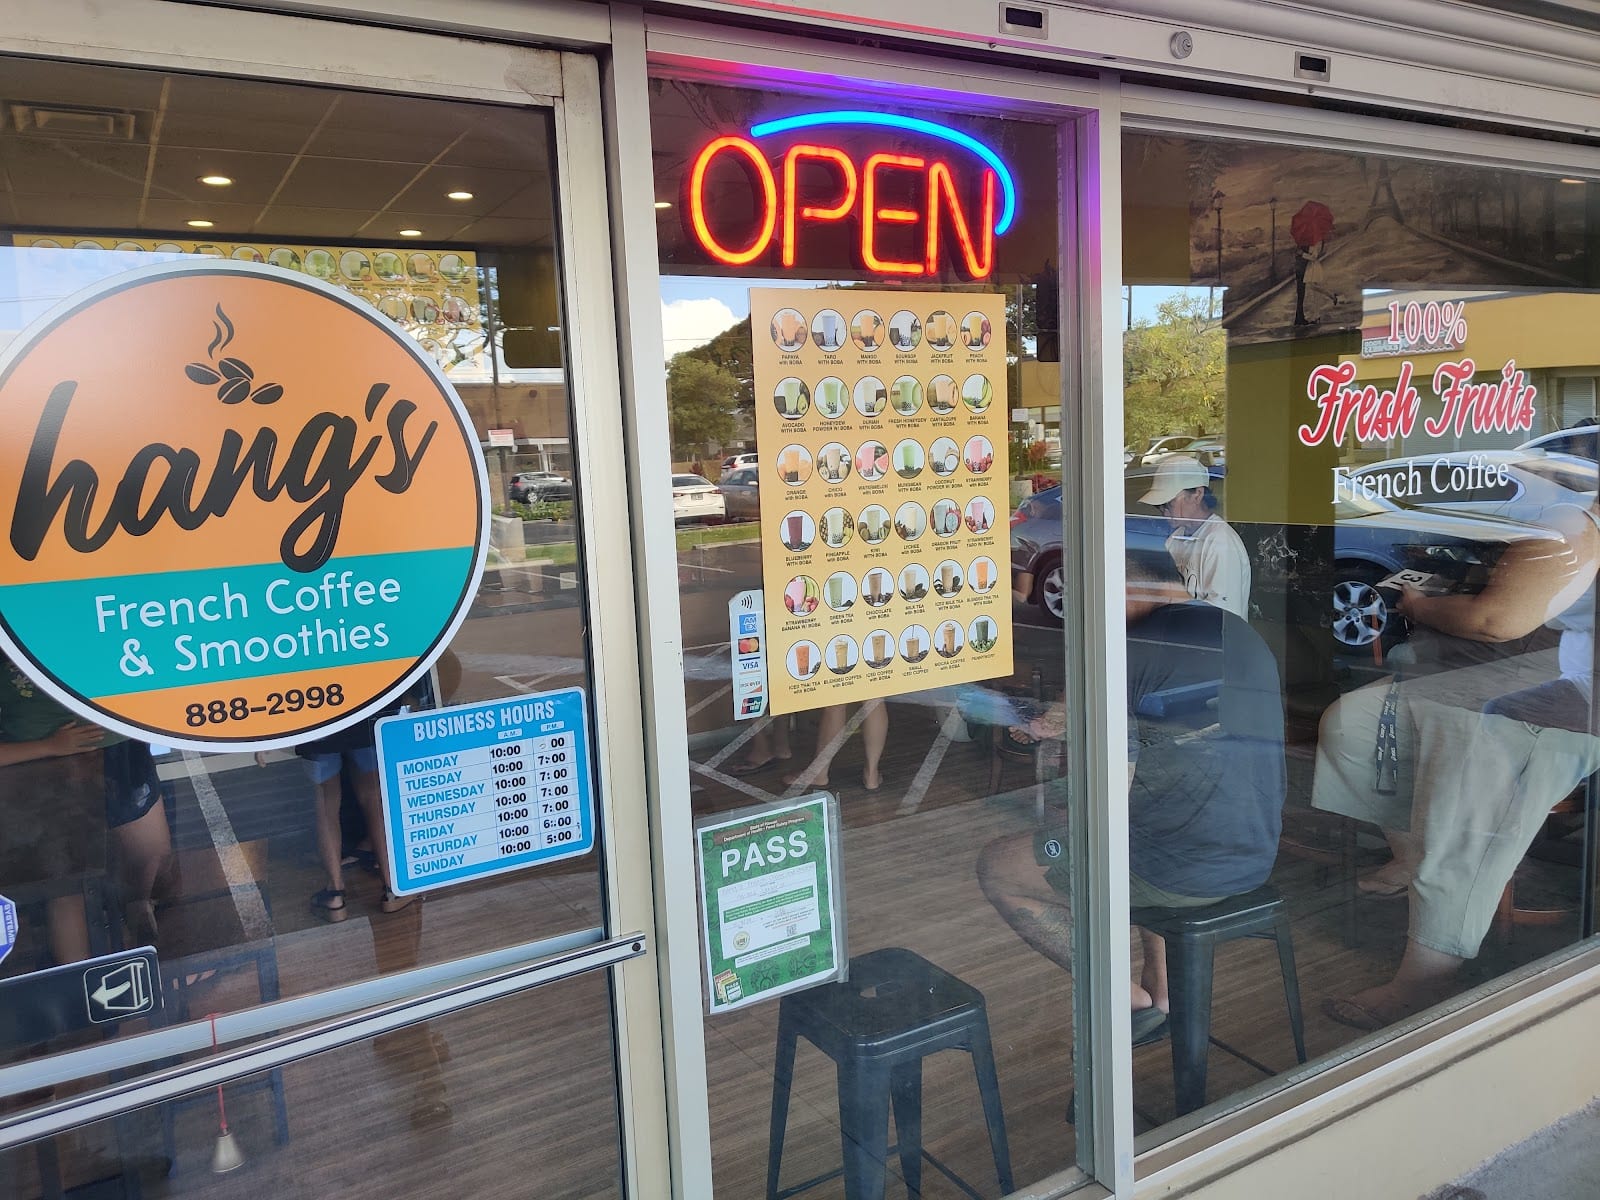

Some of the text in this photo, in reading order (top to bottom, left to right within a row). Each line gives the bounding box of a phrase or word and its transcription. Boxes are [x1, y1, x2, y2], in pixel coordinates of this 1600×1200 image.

[690, 134, 996, 280] OPEN
[1387, 300, 1468, 345] 100%
[1298, 358, 1537, 448] Fresh Fruits
[10, 380, 438, 574] hang's
[1330, 453, 1509, 504] French Coffee
[95, 570, 401, 633] French Coffee
[118, 618, 389, 678] & Smoothies
[742, 661, 759, 670] VISA
[185, 682, 345, 727] 888-2998
[413, 700, 555, 742] BUSINESS HOURS
[403, 754, 459, 776] MONDAY
[489, 744, 521, 759] 10:00
[405, 752, 566, 792] TUESDAY 10:00 7:00
[407, 768, 568, 809] WEDNESDAY 10:00 7:00
[409, 784, 569, 826] THURSDAY 10:00 7:00
[410, 799, 569, 843] FRIDAY 10:00 7:00
[412, 816, 572, 860] SATURDAY 10:00 6:00
[723, 832, 747, 842] Department
[775, 820, 788, 828] Safety
[787, 817, 805, 825] Program
[414, 830, 572, 876] SUNDAY 10:00 5:00
[721, 829, 809, 878] PASS
